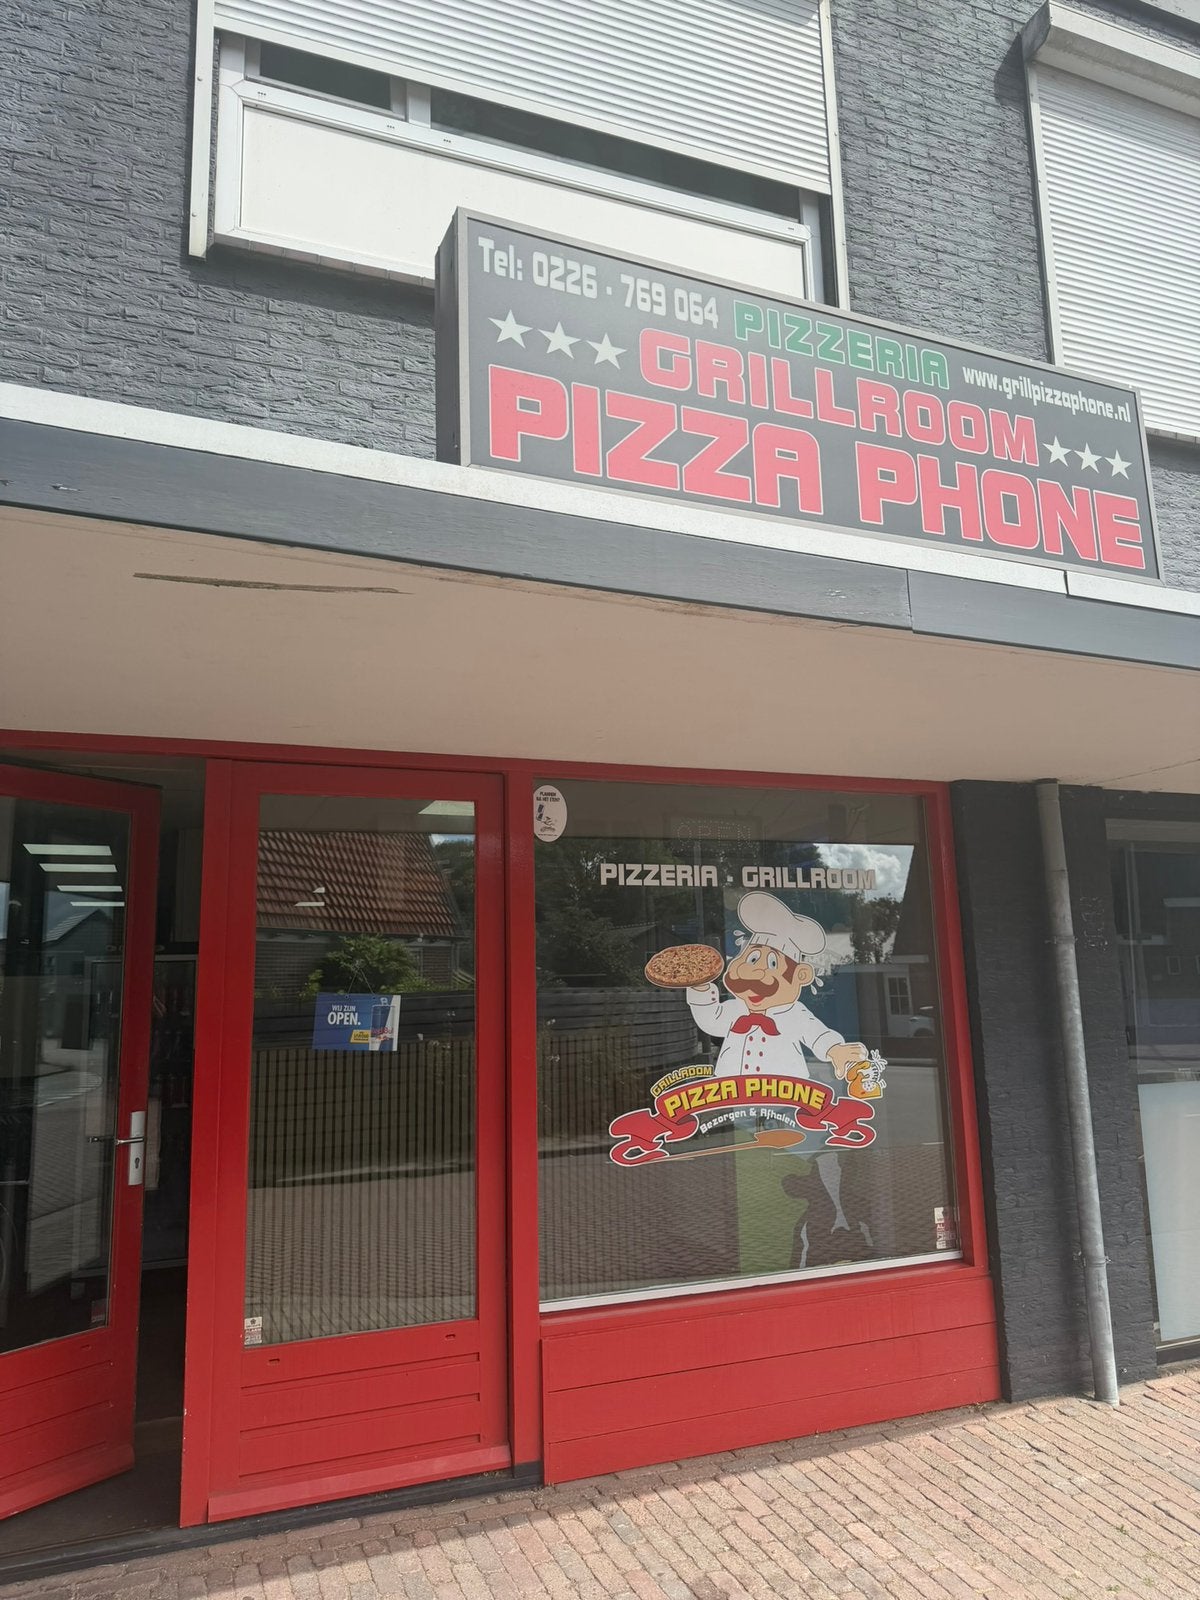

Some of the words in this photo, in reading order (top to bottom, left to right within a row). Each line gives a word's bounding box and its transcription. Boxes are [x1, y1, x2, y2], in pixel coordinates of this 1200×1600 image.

[478, 236, 523, 281] Tel:
[532, 251, 598, 299] 0226
[620, 273, 666, 317] 769
[674, 287, 719, 329] 064
[733, 299, 950, 390] PIZZERIA
[639, 327, 1040, 467] GRILLROOM
[962, 366, 1132, 424] www.grillpizzaphone.nl
[488, 363, 823, 515] PIZZA
[855, 441, 1146, 569] PHONE
[600, 862, 718, 887] PIZZERIA
[741, 866, 877, 890] GRILLROOM
[327, 1012, 362, 1026] OPEN.
[652, 1065, 713, 1097] GRILLROOM
[663, 1079, 739, 1119] PIZZA
[745, 1078, 827, 1111] PHONE
[699, 1109, 748, 1134] Bezorgen
[749, 1107, 757, 1117] &
[760, 1108, 797, 1129] Afhalen
